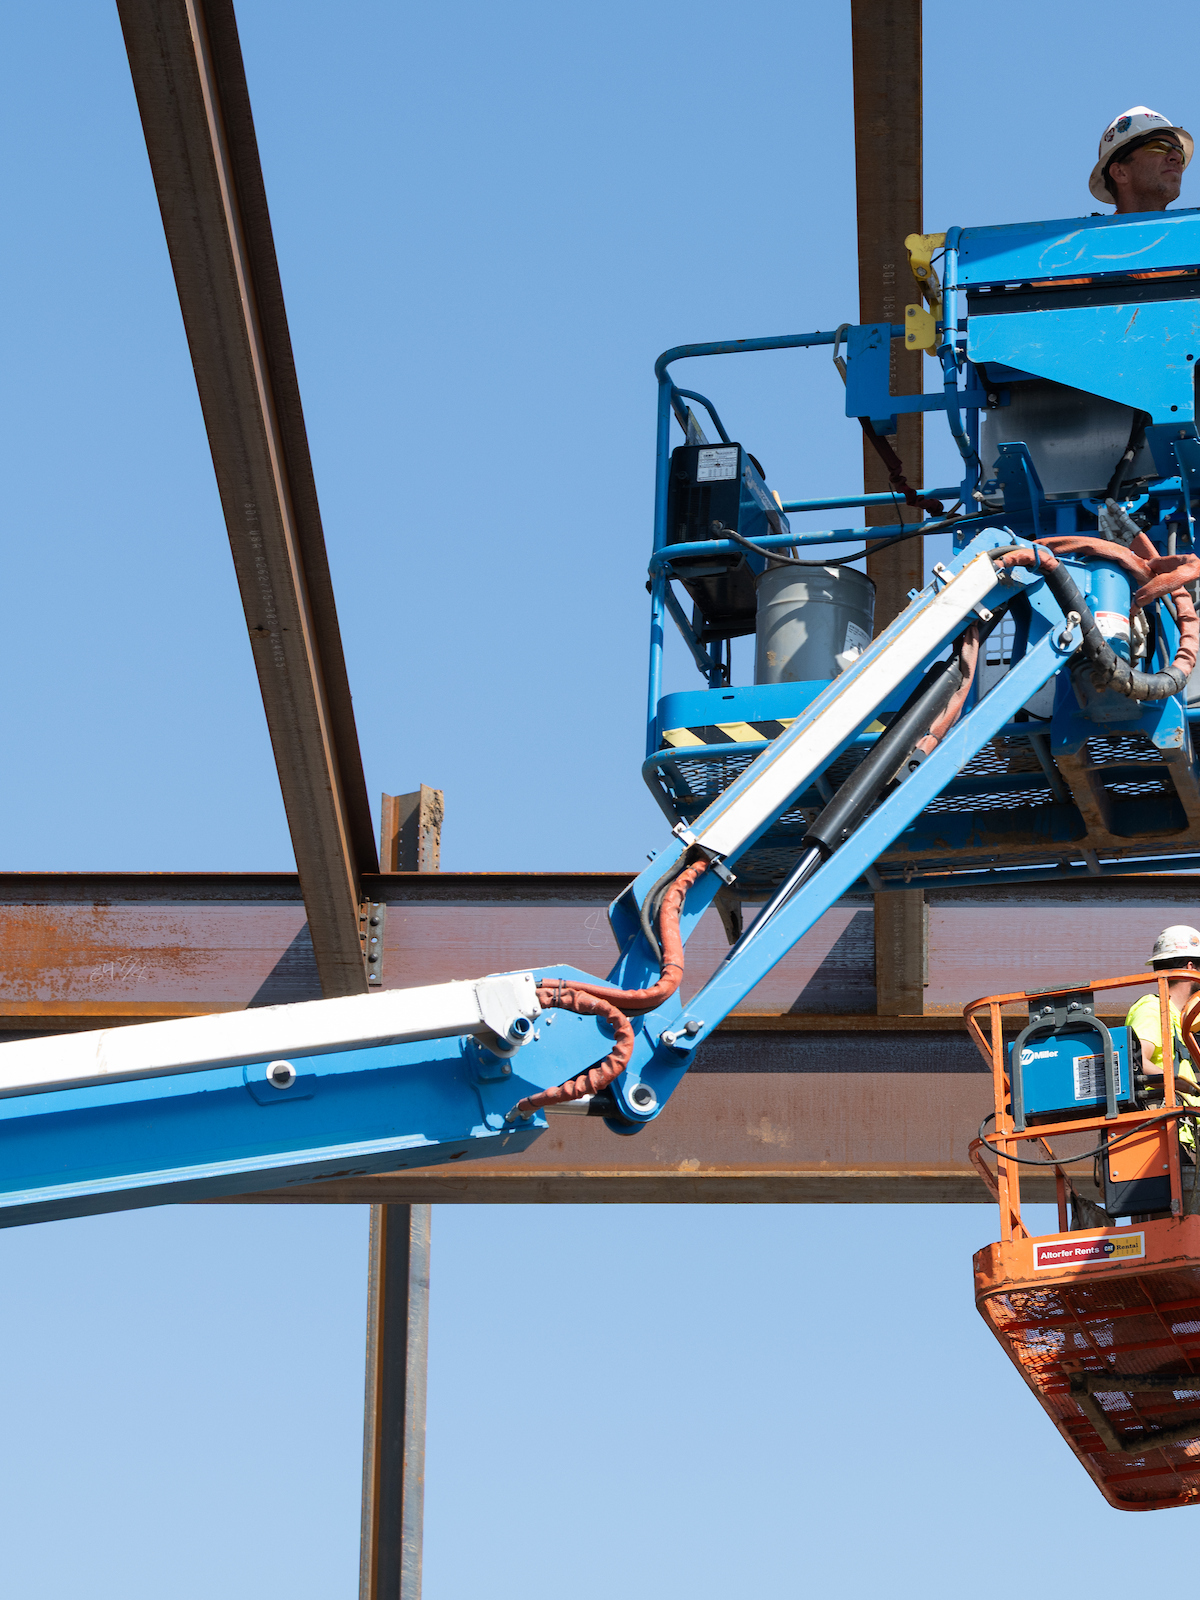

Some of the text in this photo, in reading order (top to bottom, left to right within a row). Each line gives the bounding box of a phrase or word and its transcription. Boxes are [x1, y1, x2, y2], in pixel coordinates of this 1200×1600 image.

[883, 296, 896, 318] USA
[1034, 1050, 1059, 1060] Miller
[1040, 1249, 1073, 1260] Altorfer
[1074, 1247, 1100, 1256] Rents
